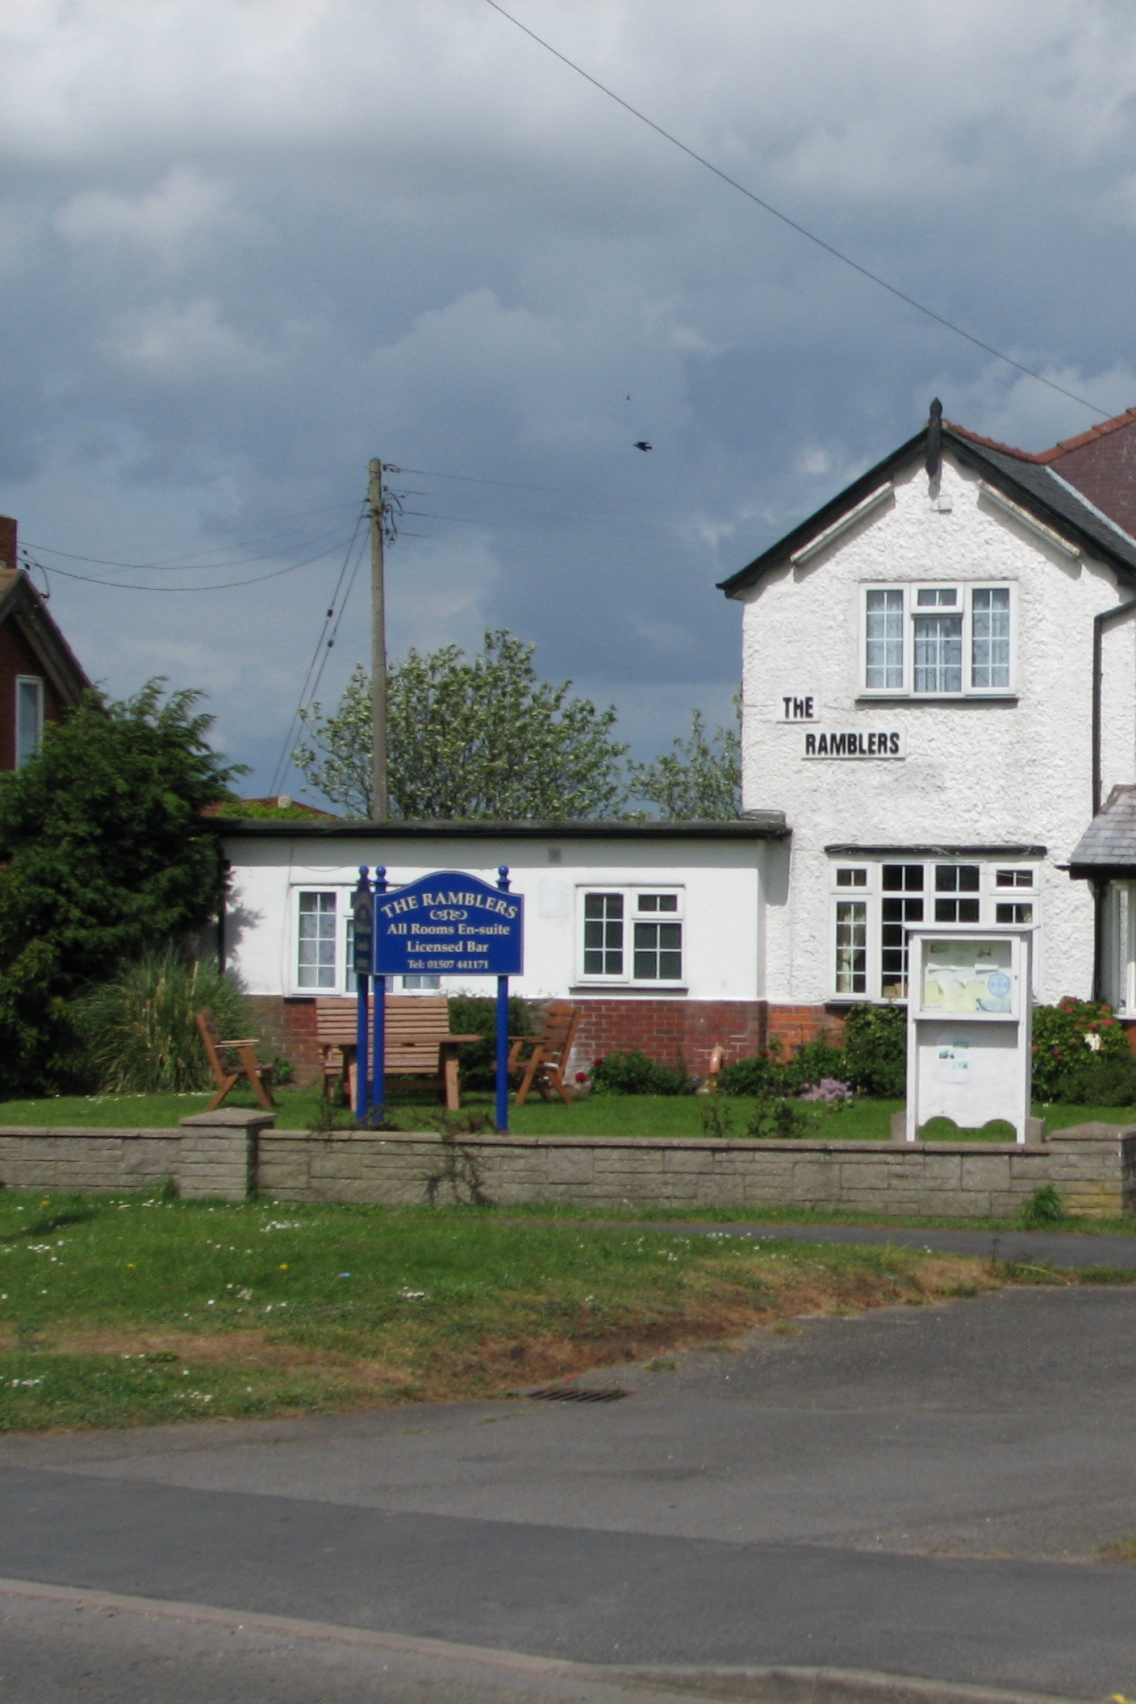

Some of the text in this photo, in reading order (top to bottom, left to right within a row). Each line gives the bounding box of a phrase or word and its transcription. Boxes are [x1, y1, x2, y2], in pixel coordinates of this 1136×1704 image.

[782, 696, 814, 719] THE
[805, 732, 900, 756] RAMBLERS
[380, 896, 419, 919] THE
[421, 891, 519, 920] RAMBLERS
[387, 923, 510, 935] All Rooms En-suite
[406, 941, 489, 952] Licensed Bar
[407, 959, 425, 969] Tel:
